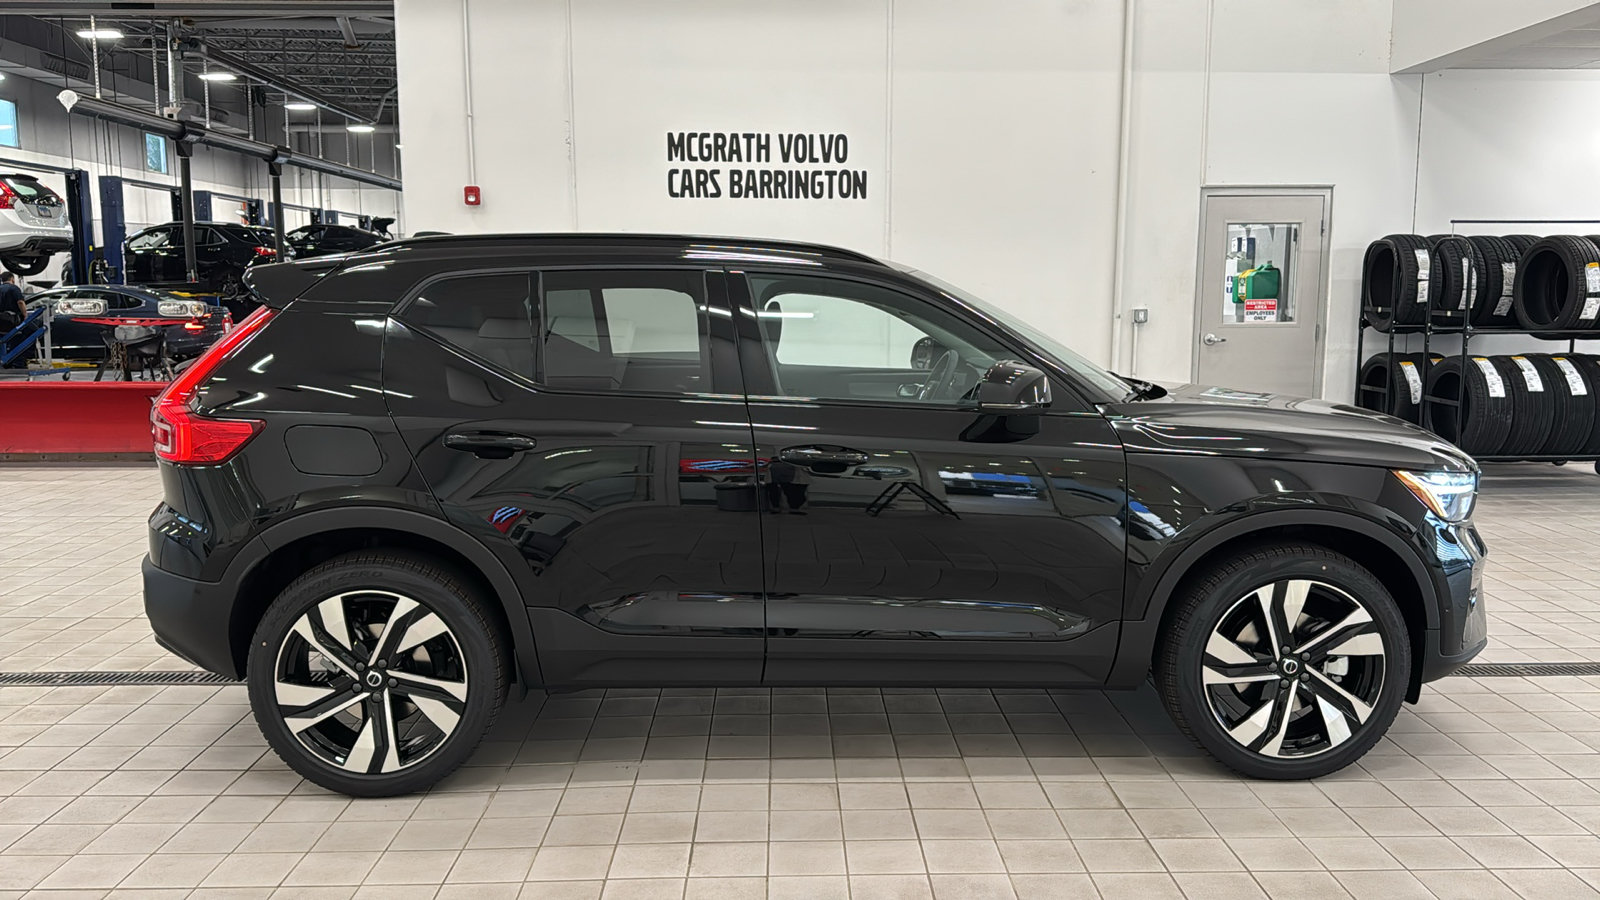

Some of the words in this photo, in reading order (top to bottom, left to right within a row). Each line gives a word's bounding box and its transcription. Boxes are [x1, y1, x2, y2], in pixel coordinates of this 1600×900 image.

[667, 132, 770, 163] MCGRATH
[778, 133, 848, 164] VOLVO
[667, 168, 722, 198] CARS
[729, 169, 867, 199] BARRINGTON
